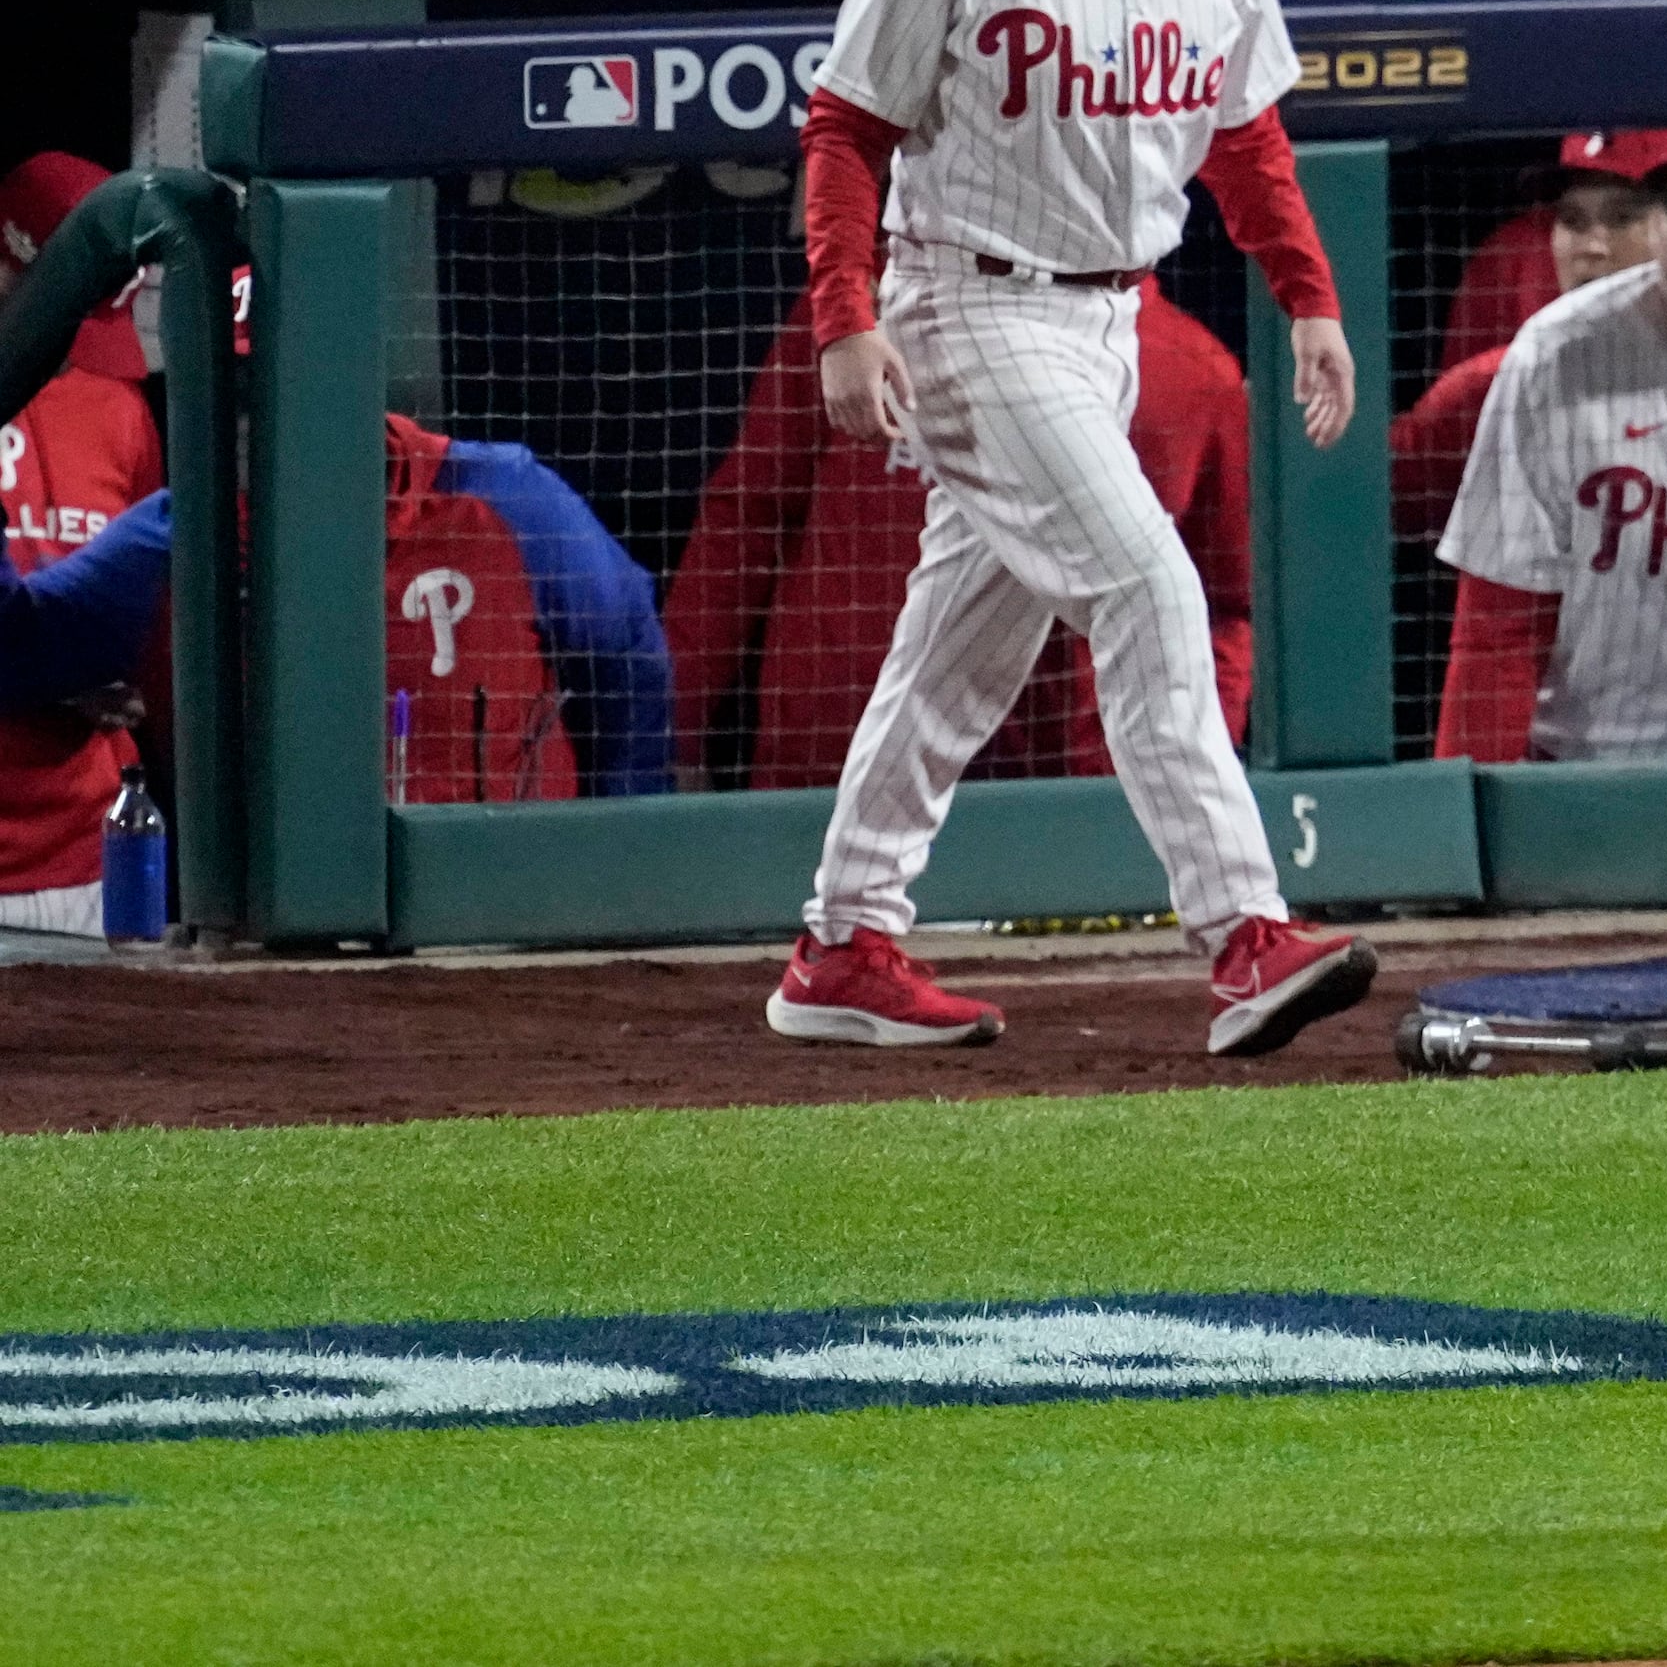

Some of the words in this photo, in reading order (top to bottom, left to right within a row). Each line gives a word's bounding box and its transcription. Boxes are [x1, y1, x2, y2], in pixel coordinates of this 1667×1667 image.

[1291, 45, 1469, 90] 2022
[401, 567, 476, 679] P
[1292, 793, 1318, 868] 5
